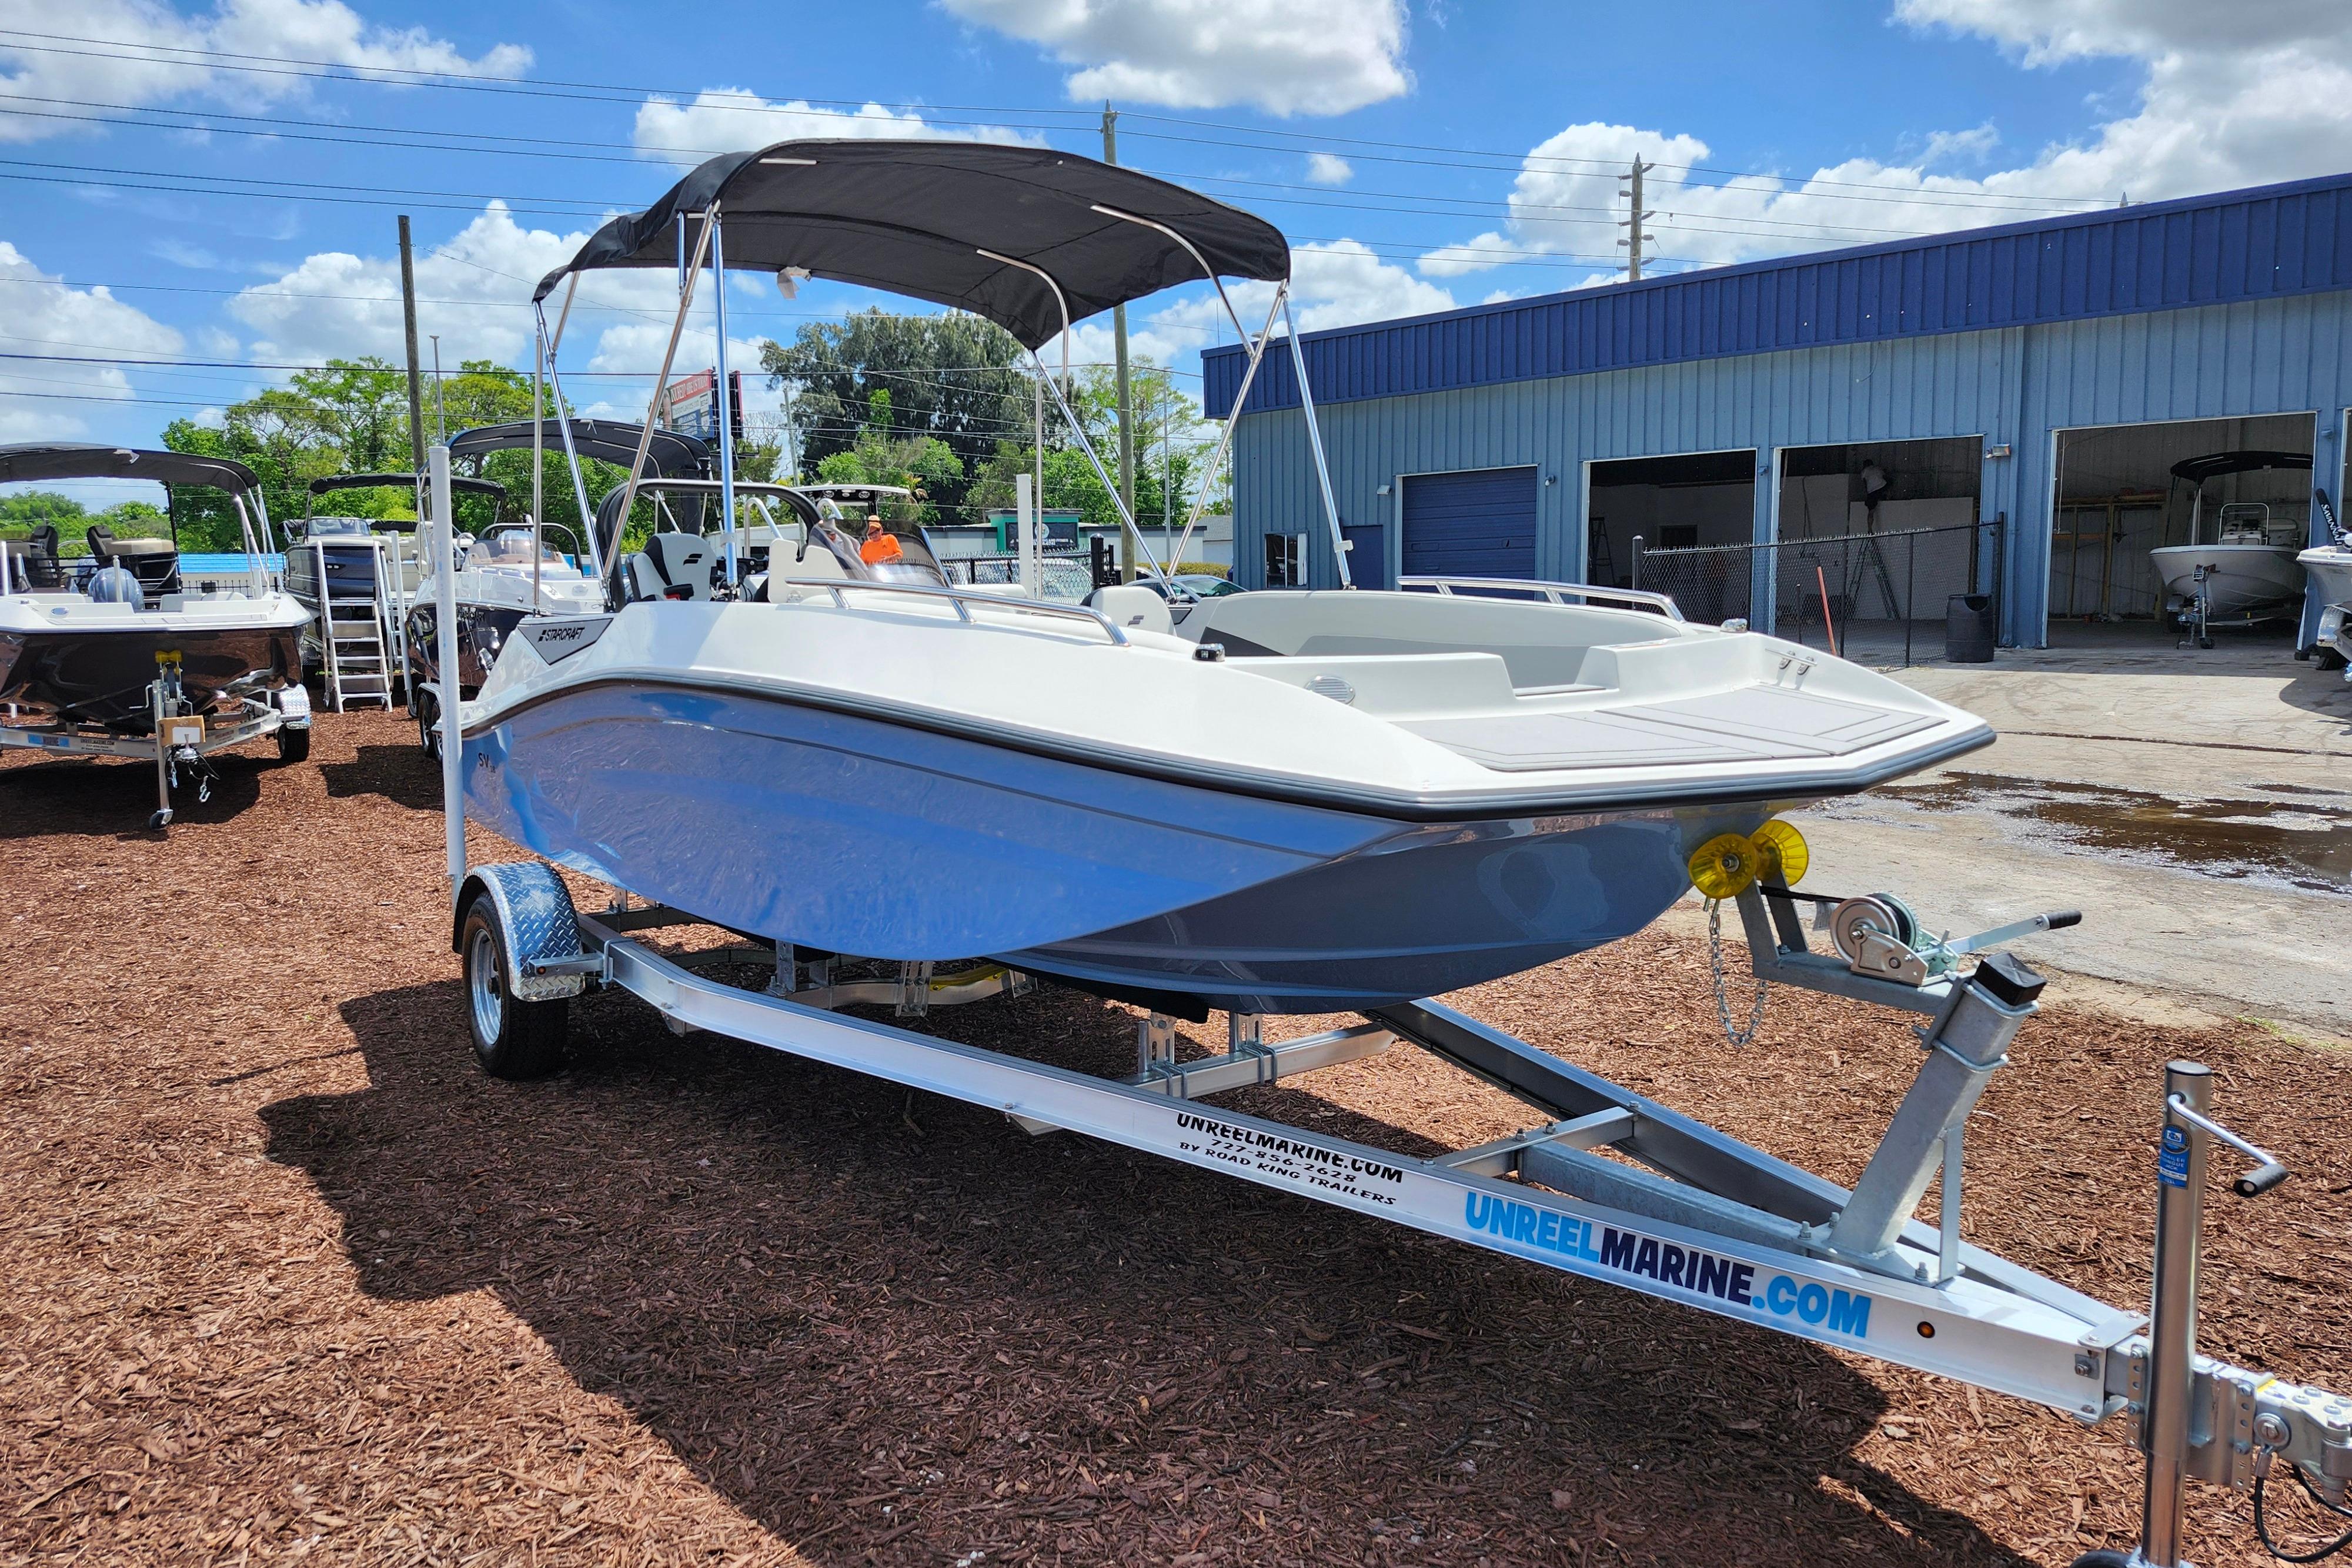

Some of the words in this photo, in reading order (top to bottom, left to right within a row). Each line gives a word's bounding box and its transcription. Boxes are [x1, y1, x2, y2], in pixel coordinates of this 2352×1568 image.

[2321, 504, 2342, 545] SAVANNAH
[545, 627, 585, 642] STARCRAFT
[478, 753, 489, 768] SV
[1177, 1113, 1403, 1183] UNREELMARINE.COM
[1211, 1139, 1357, 1182] 727-856-2628
[1180, 1142, 1200, 1152] BY
[1205, 1148, 1251, 1165] ROAD
[1257, 1162, 1300, 1179] KING
[1309, 1176, 1396, 1205] TRAILERS
[1465, 1192, 1872, 1338] UNREELMARINE.COM
